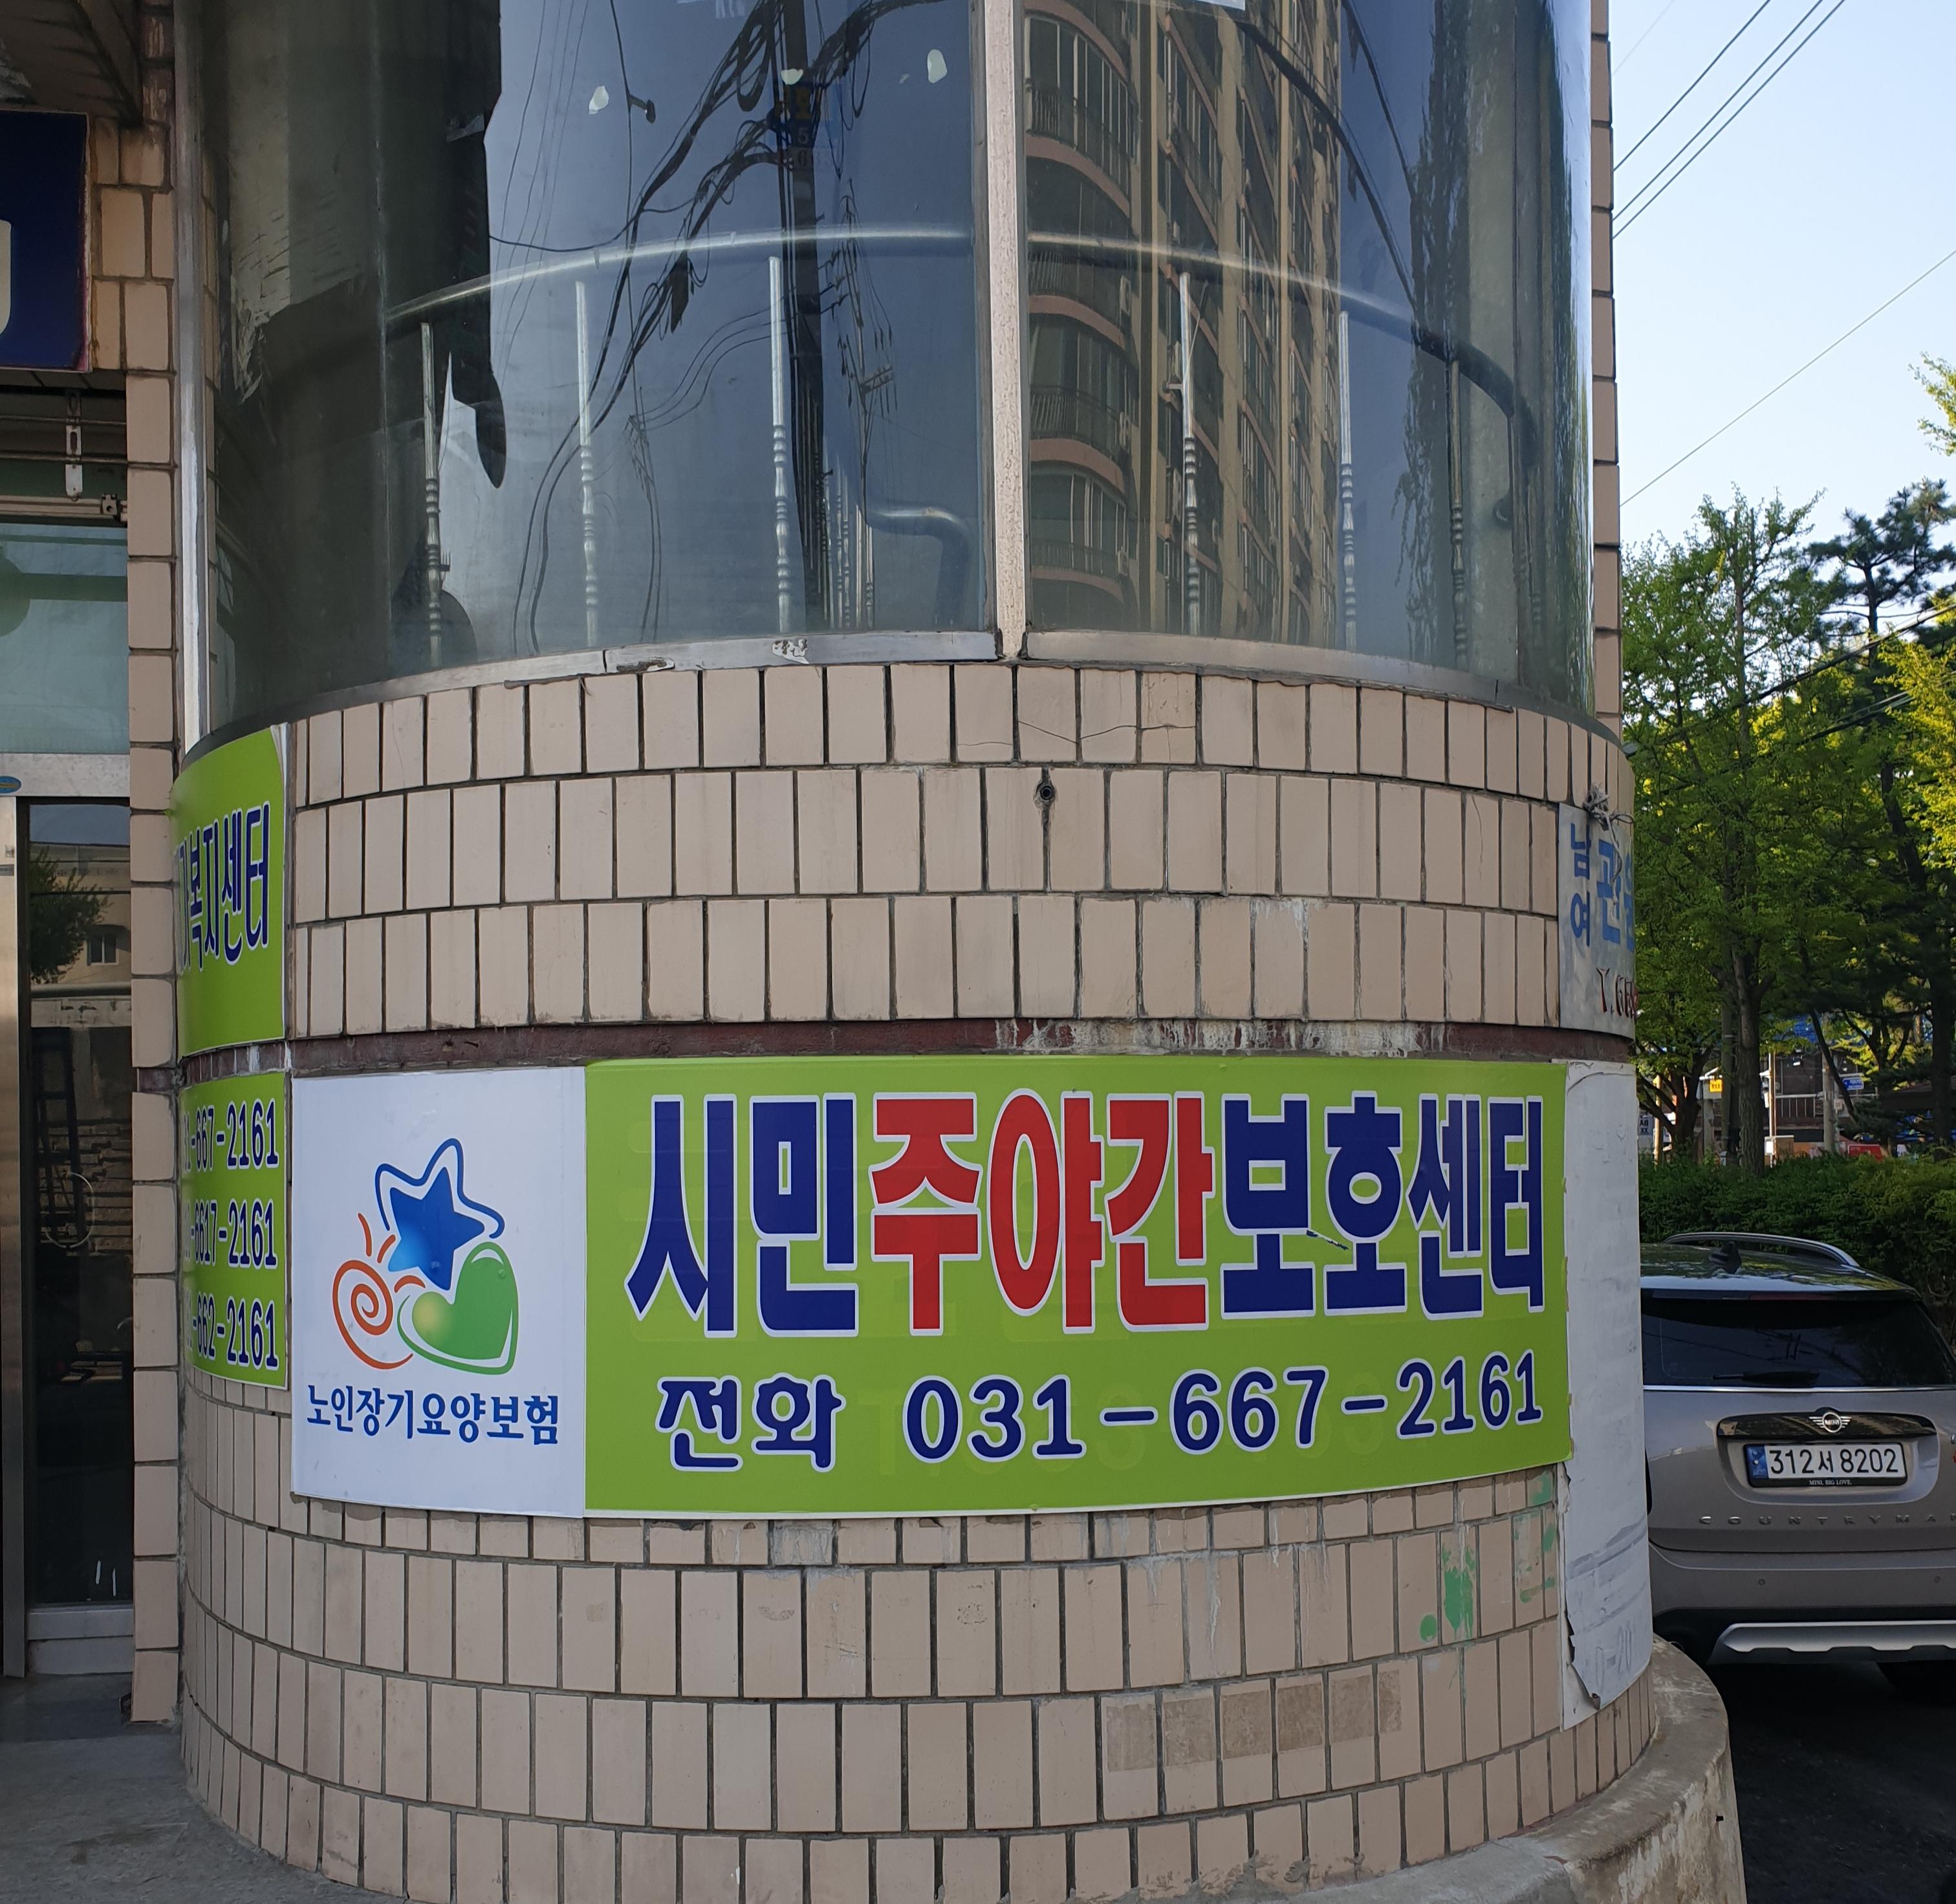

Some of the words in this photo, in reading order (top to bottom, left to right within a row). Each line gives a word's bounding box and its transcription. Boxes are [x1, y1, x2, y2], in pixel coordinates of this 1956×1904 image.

[175, 800, 270, 973] 가복지센터
[307, 1384, 559, 1445] 노인장기요양보험
[655, 1372, 846, 1472] 전화
[903, 1349, 1544, 1463] 031-667-2161
